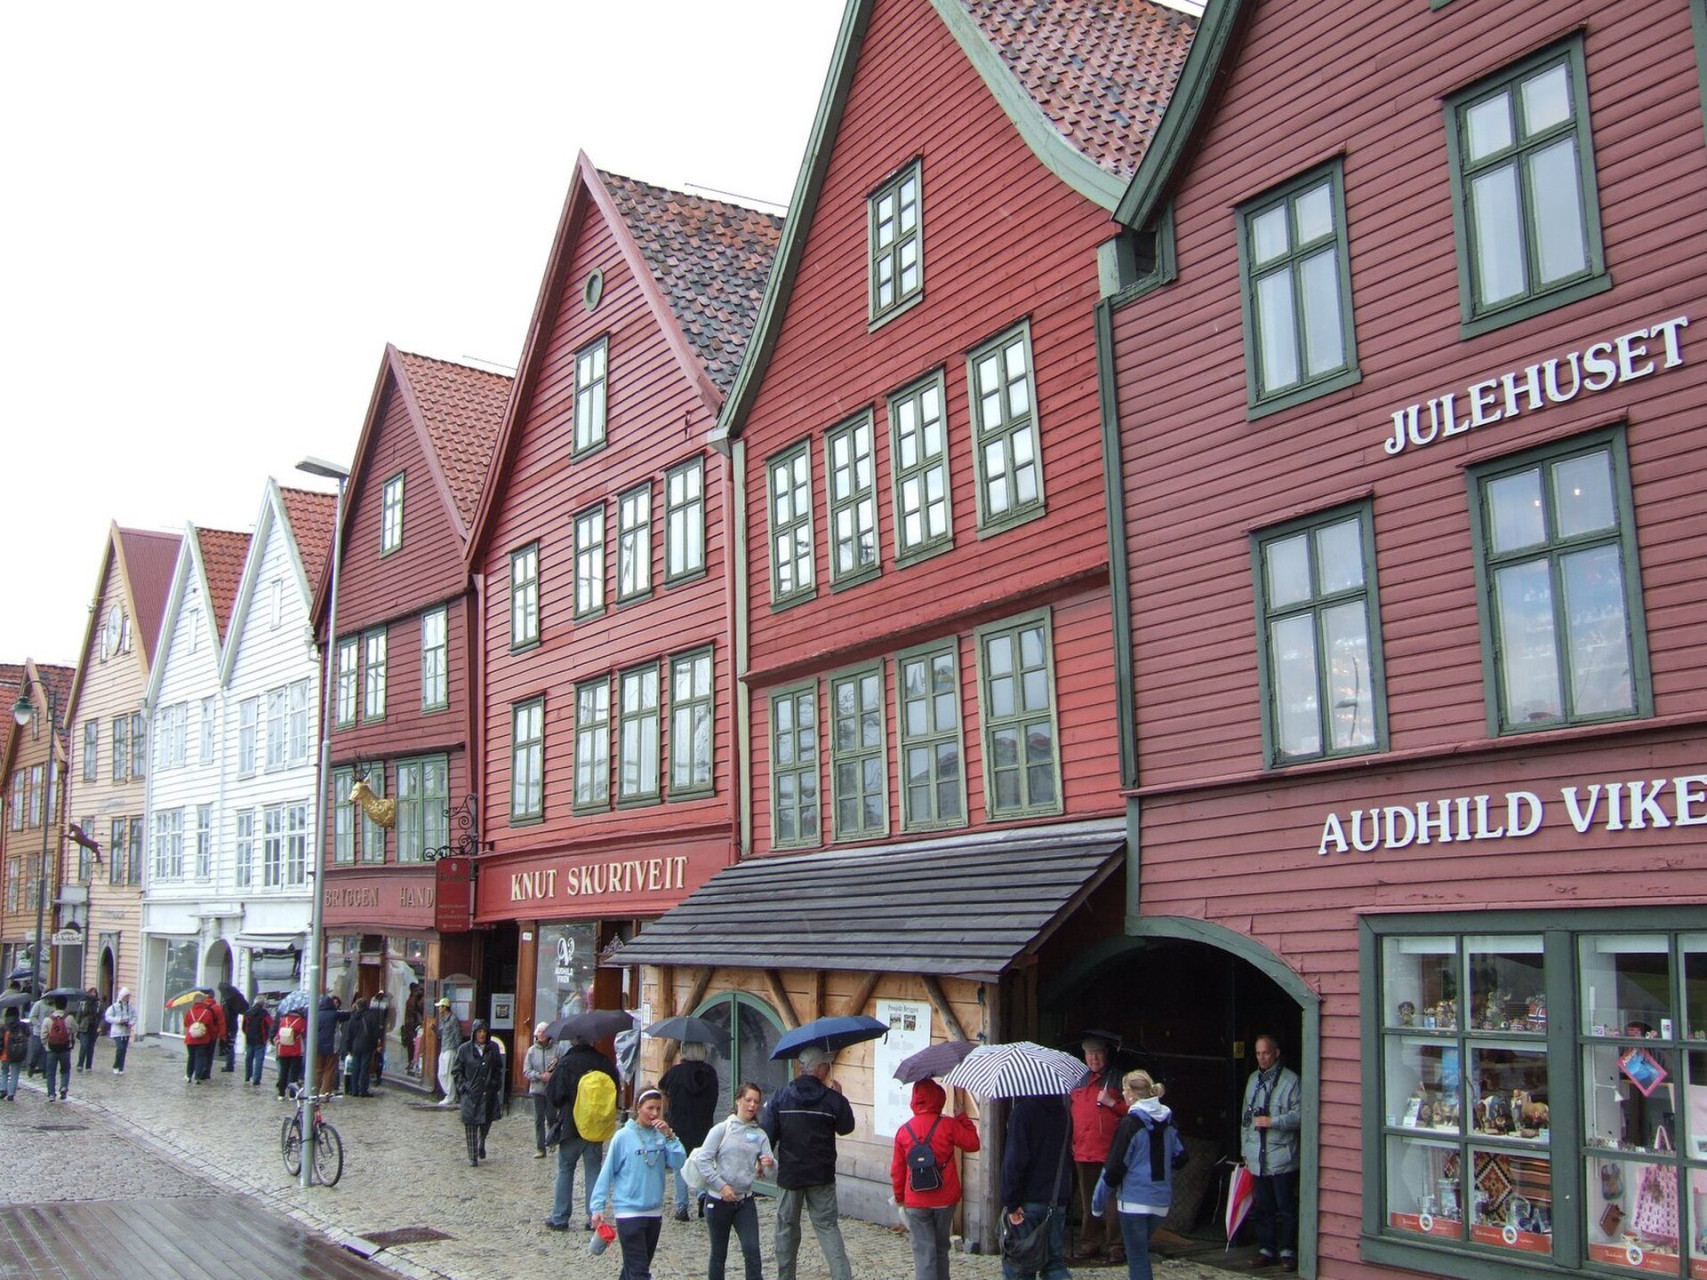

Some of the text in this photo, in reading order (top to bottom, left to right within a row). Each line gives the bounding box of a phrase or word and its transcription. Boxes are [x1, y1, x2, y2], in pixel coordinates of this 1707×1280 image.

[1384, 315, 1690, 455] JULEHUSET
[1318, 773, 1707, 856] AUDHILD VIKE
[325, 887, 434, 909] BRYGGEN HAND
[511, 856, 689, 901] KNUT SKURTVEIT
